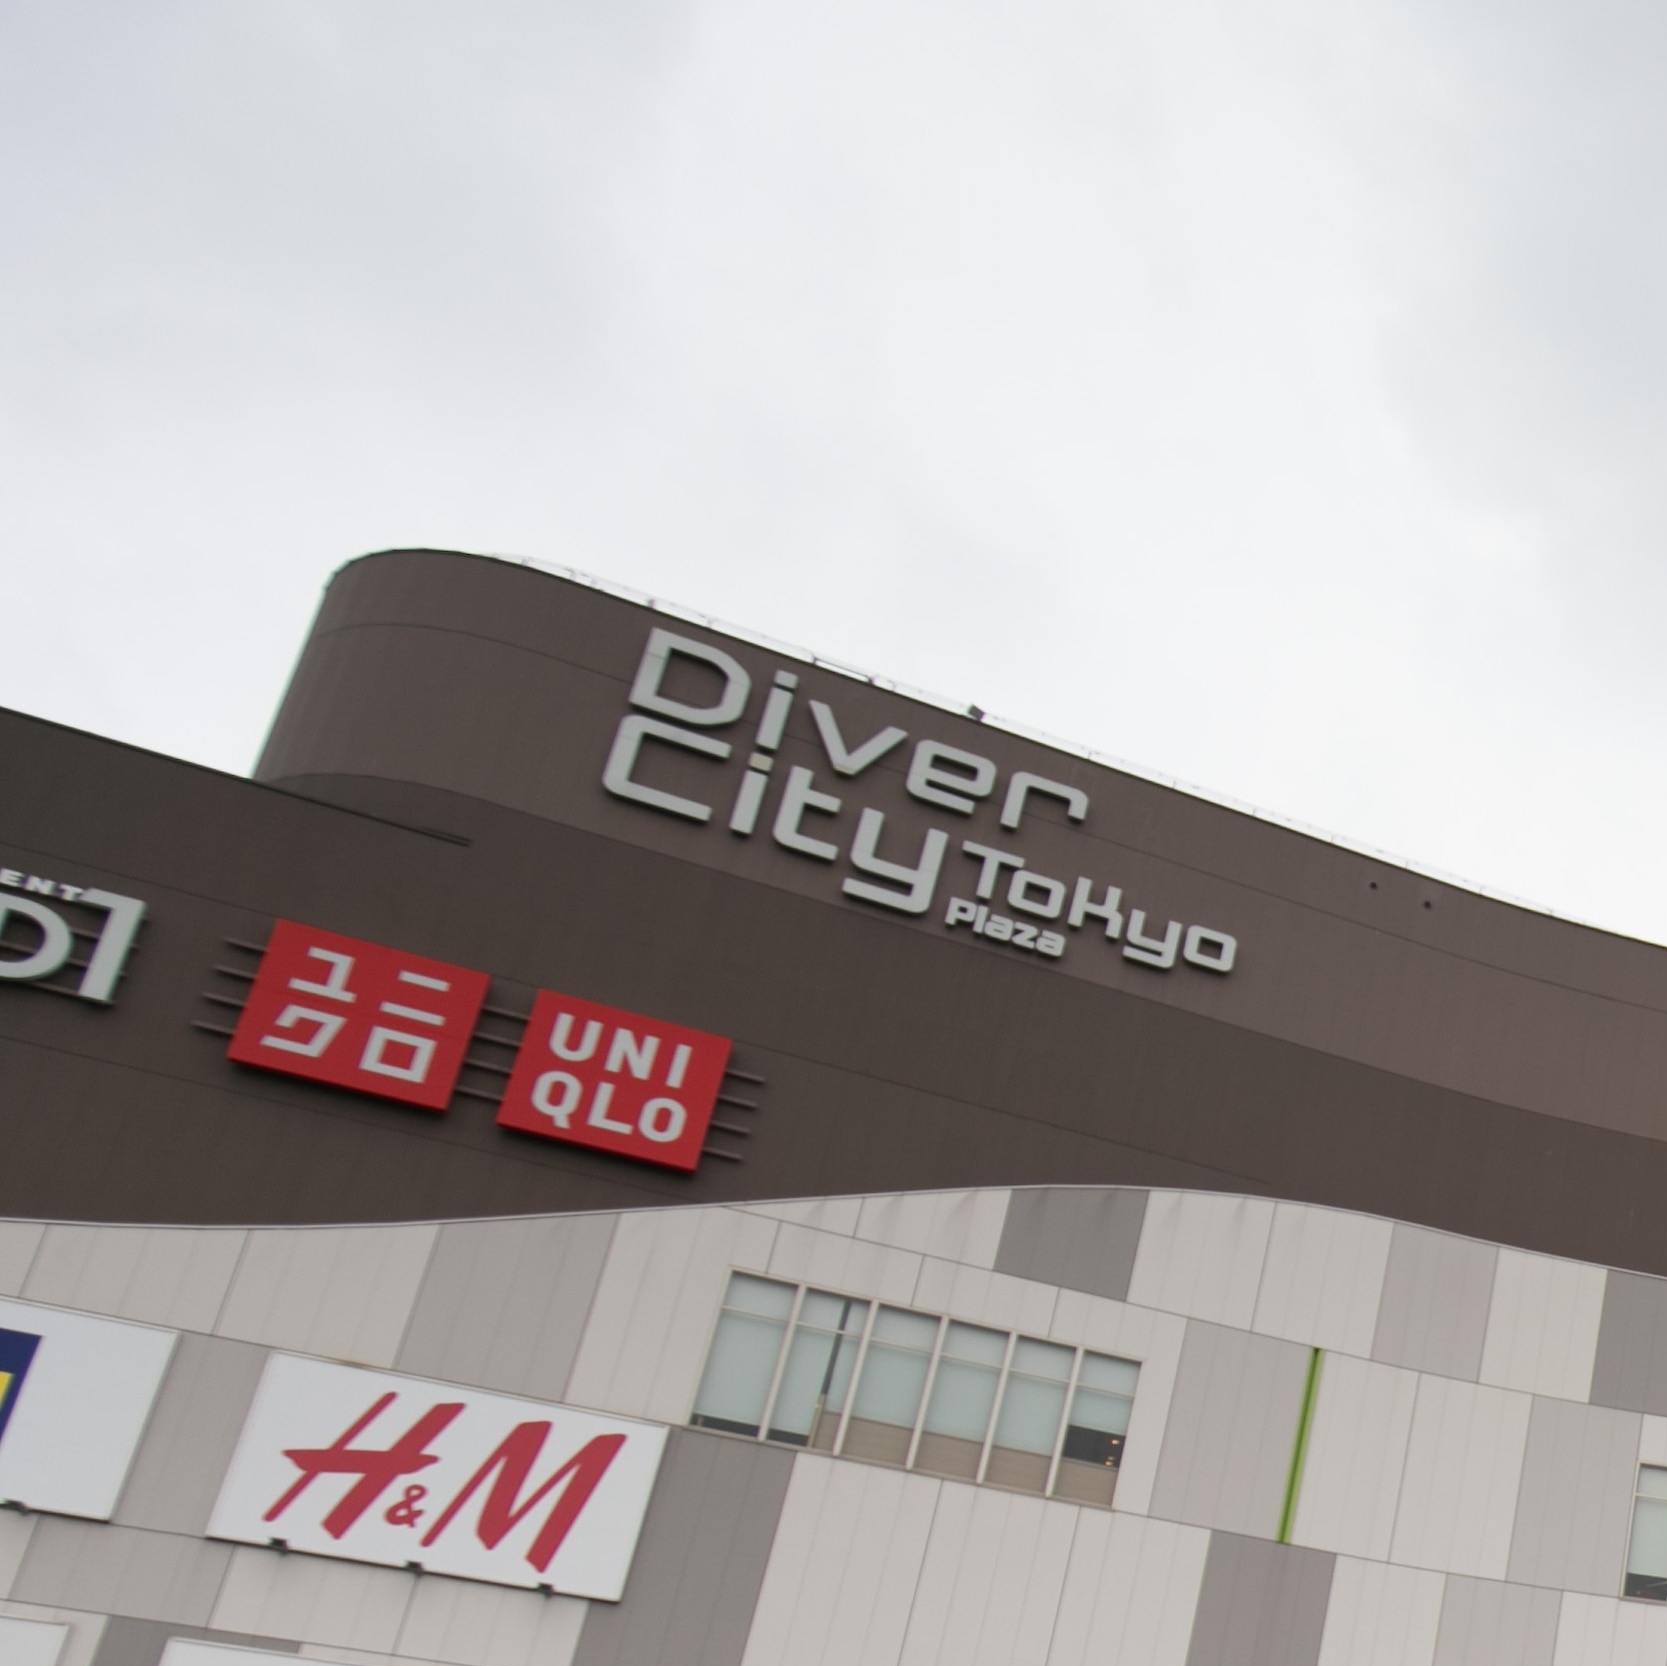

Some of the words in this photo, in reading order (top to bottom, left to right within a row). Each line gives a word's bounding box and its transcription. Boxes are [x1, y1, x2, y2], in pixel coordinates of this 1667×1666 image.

[628, 627, 1089, 829] Diver
[603, 714, 949, 913] City
[945, 897, 1065, 956] Plaza
[289, 947, 450, 1026] ユニ
[260, 1004, 437, 1083] クロ
[549, 1012, 692, 1088] UNI
[532, 1071, 687, 1143] QLO
[262, 1392, 626, 1573] H&M
